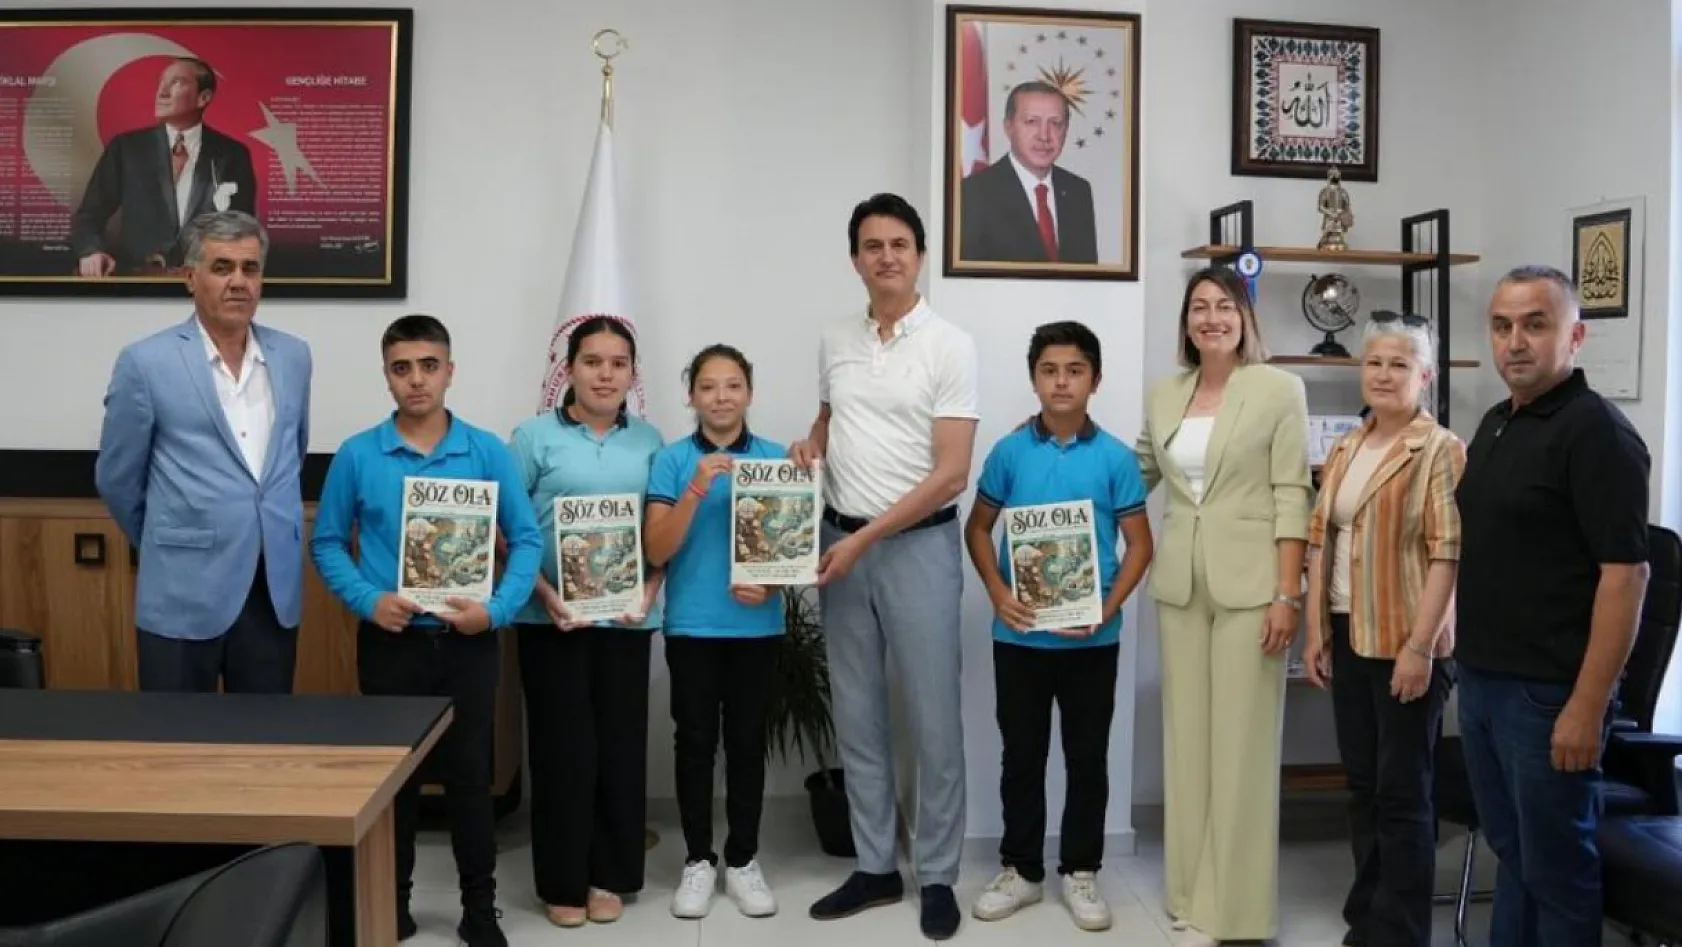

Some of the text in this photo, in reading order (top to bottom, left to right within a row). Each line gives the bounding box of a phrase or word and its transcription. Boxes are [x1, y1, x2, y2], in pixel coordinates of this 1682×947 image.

[408, 480, 492, 508] SÖZ OLA
[560, 499, 635, 523] SÖZ OLA
[1010, 508, 1048, 535] SÖZ
[1051, 507, 1088, 526] OLA
